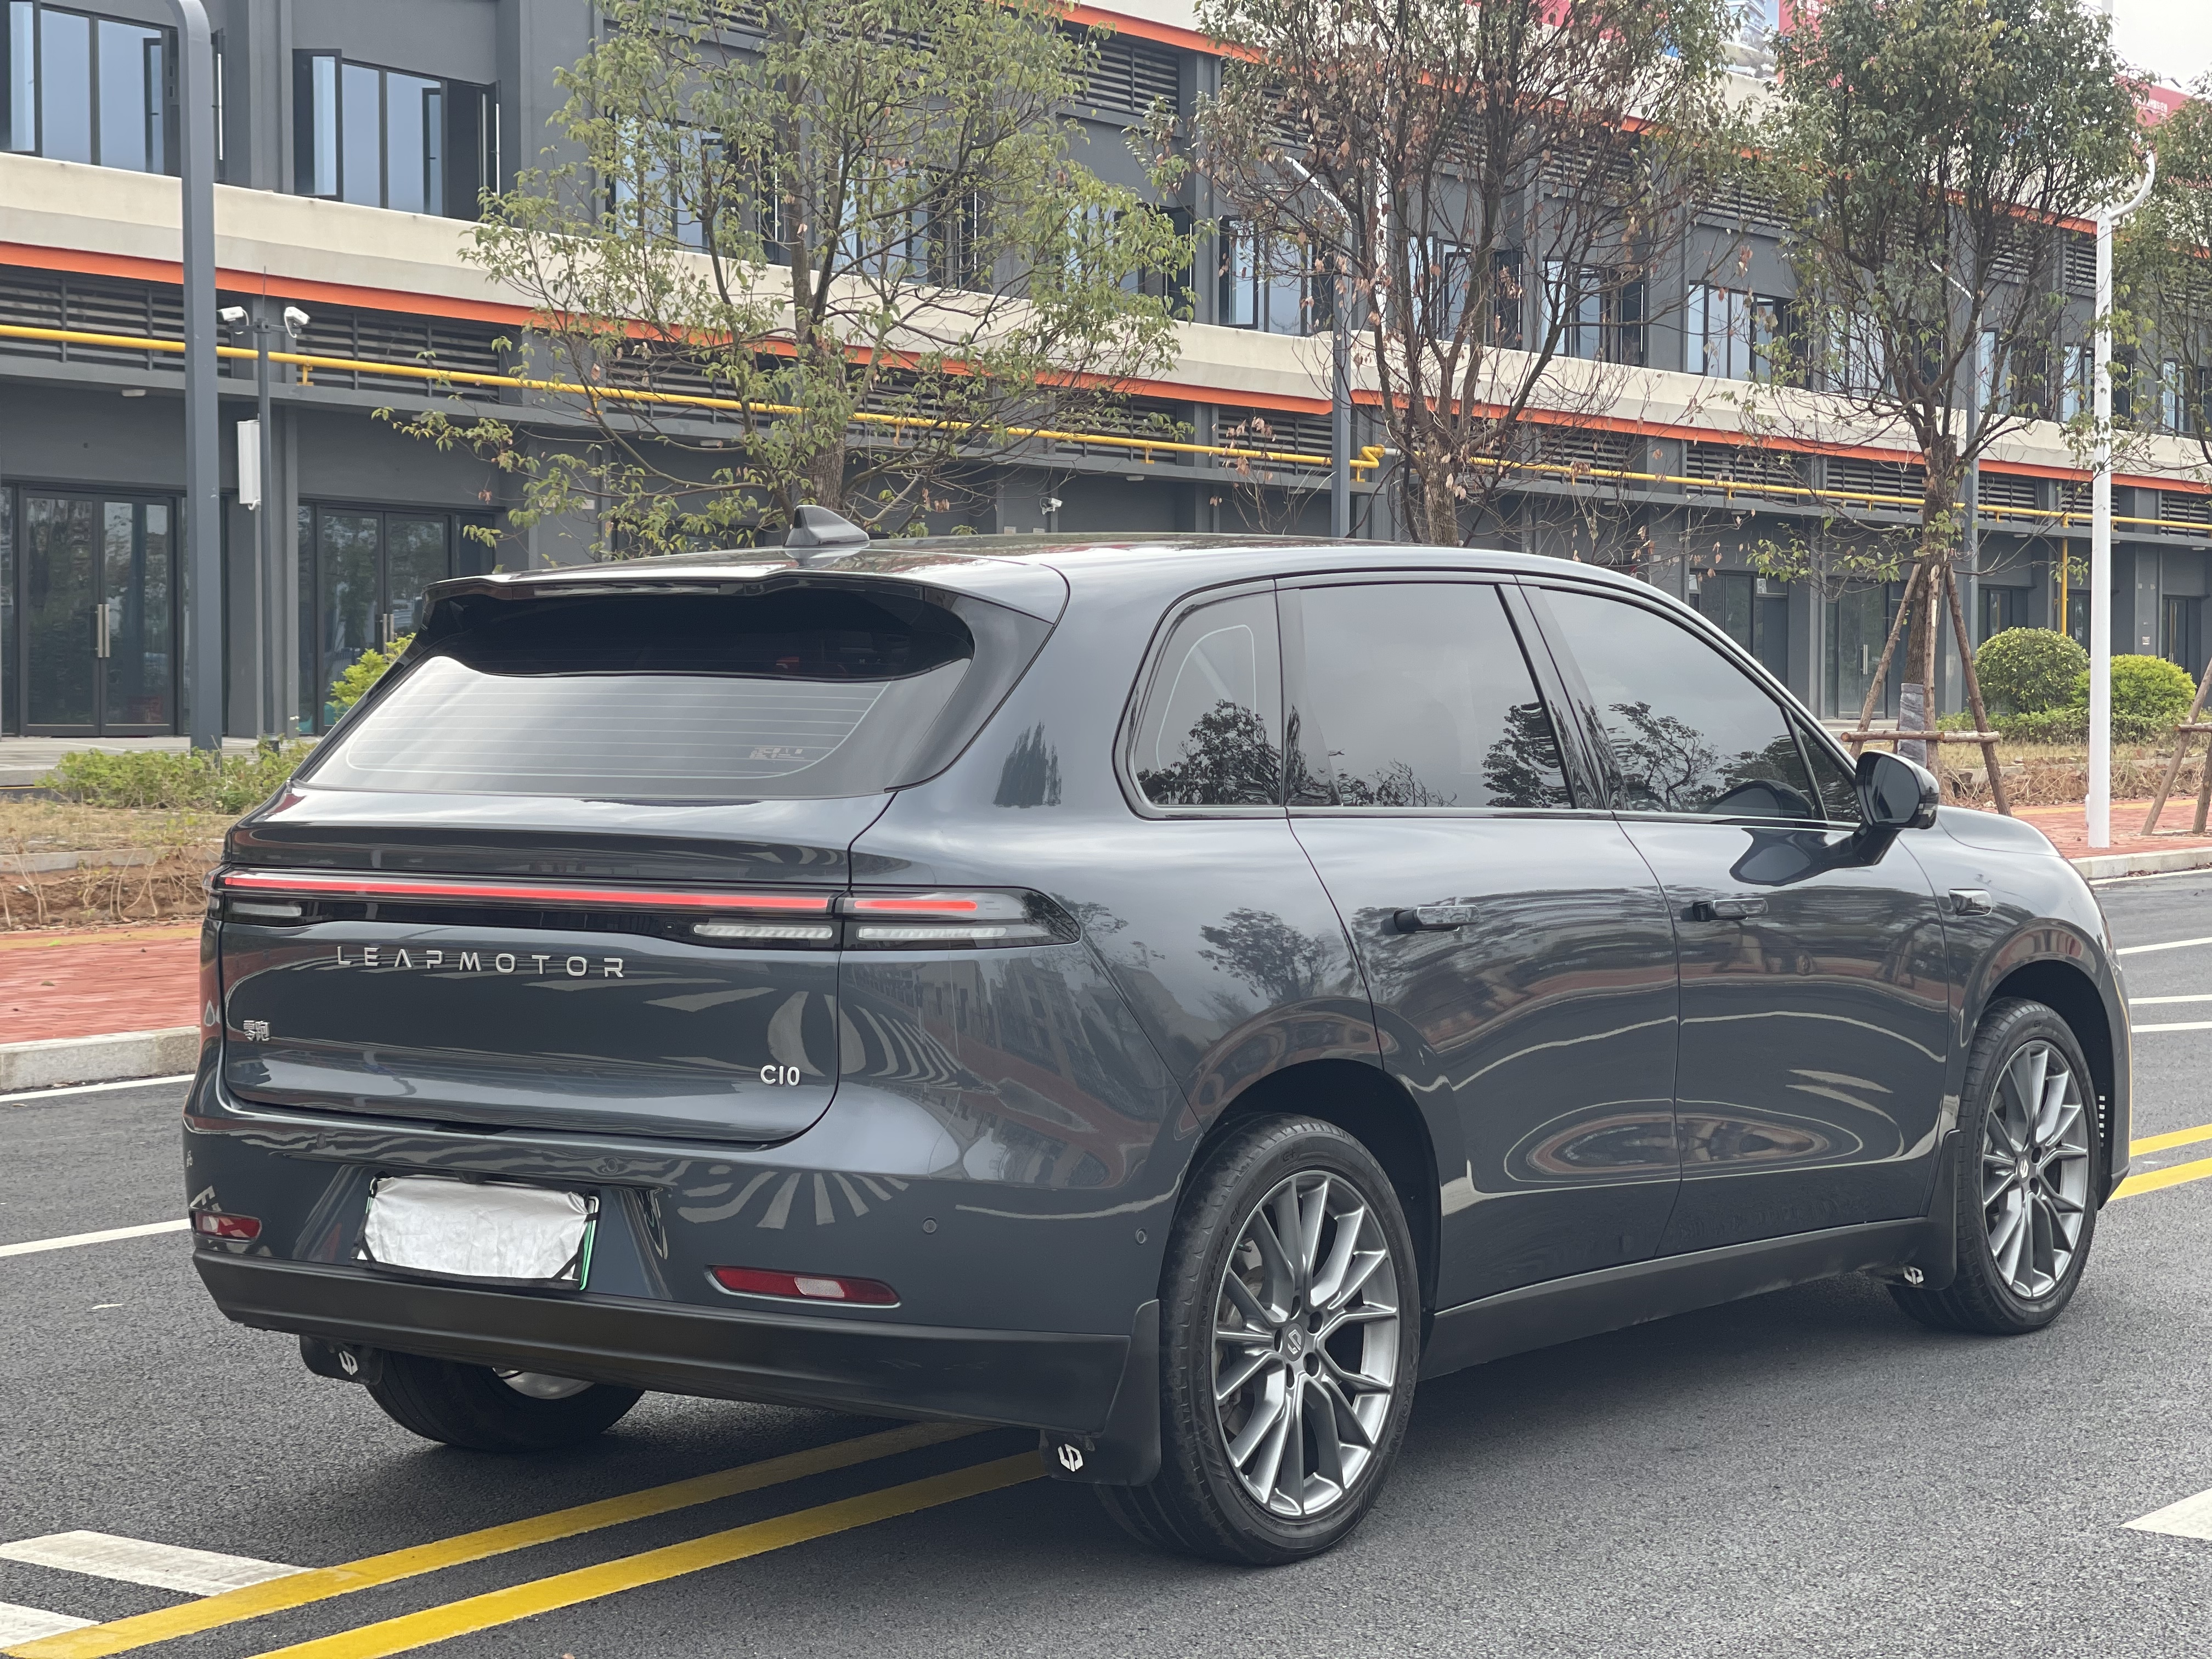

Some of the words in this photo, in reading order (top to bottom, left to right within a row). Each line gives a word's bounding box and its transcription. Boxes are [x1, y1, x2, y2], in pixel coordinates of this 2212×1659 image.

[337, 946, 624, 978] LEAPMOTOR
[243, 1019, 270, 1042] 零跑
[760, 1064, 800, 1086] C10
